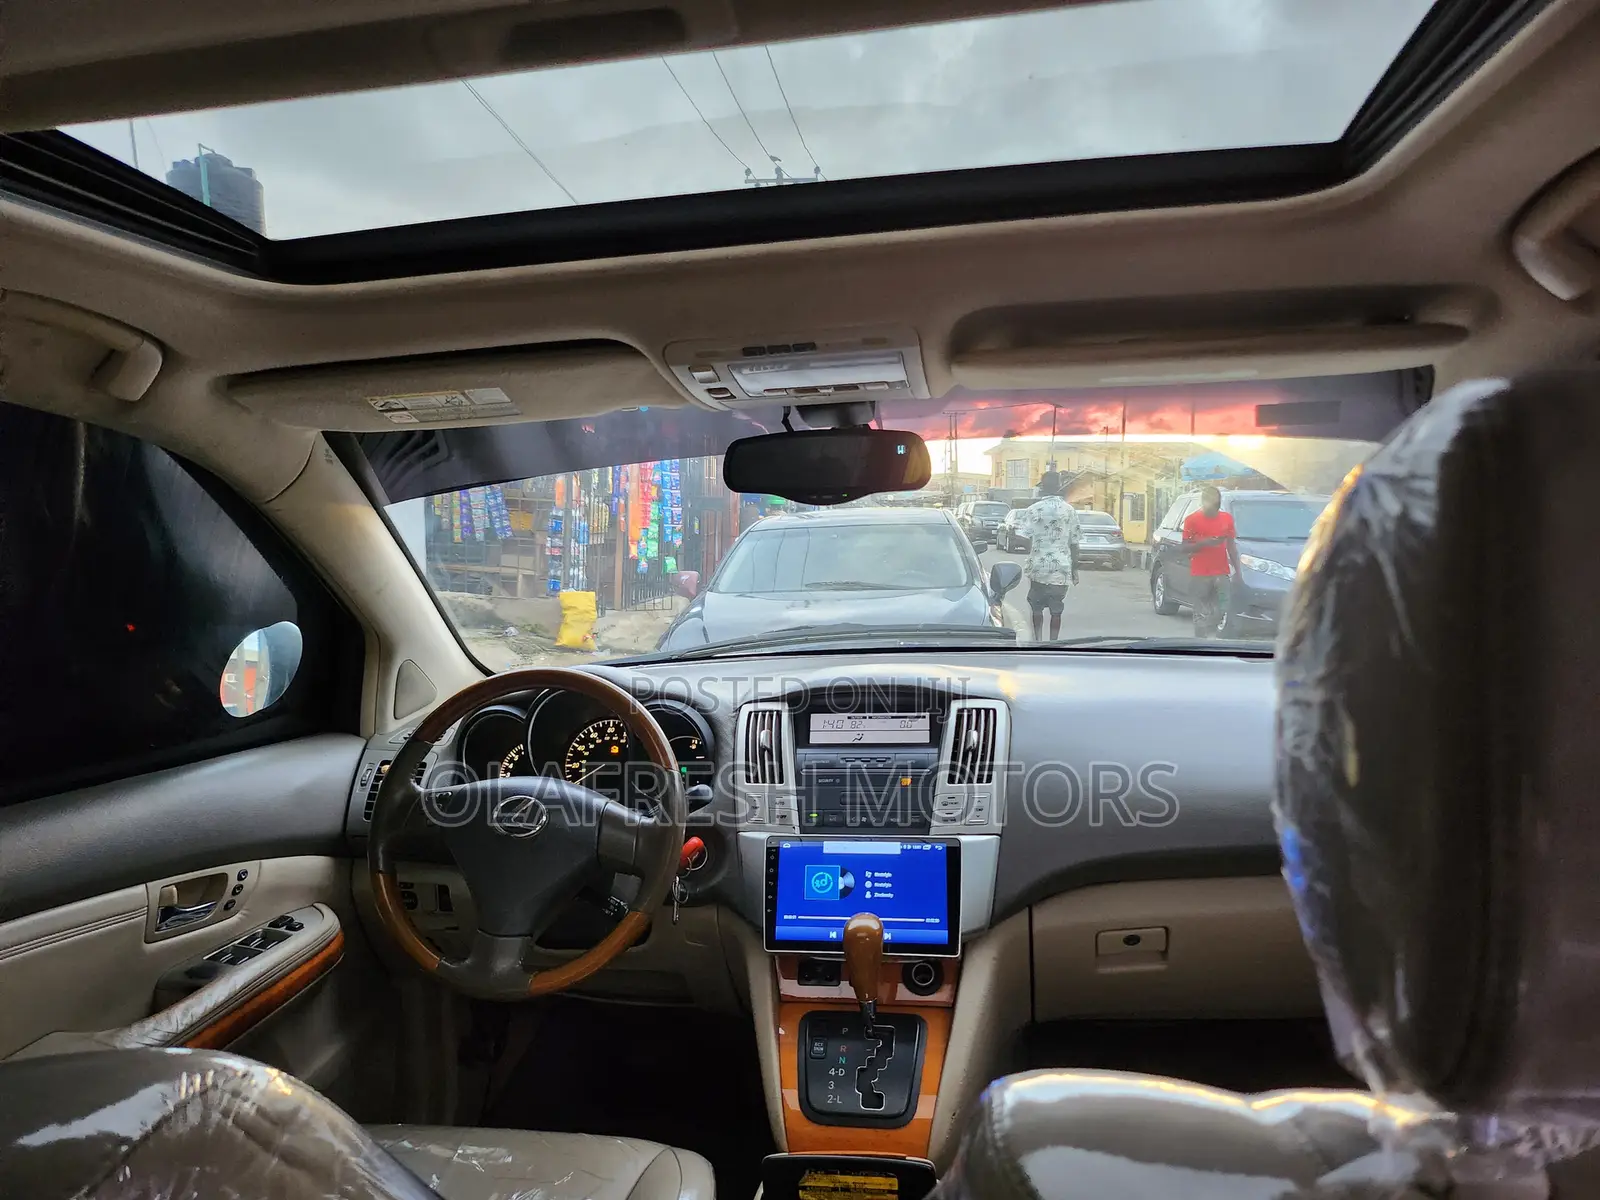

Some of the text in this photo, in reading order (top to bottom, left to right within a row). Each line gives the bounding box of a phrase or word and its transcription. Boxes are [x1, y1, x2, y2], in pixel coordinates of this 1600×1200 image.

[839, 1056, 846, 1064] N
[829, 1068, 845, 1076] 4-D
[828, 1080, 834, 1090] 3
[827, 1095, 842, 1104] 2-L
